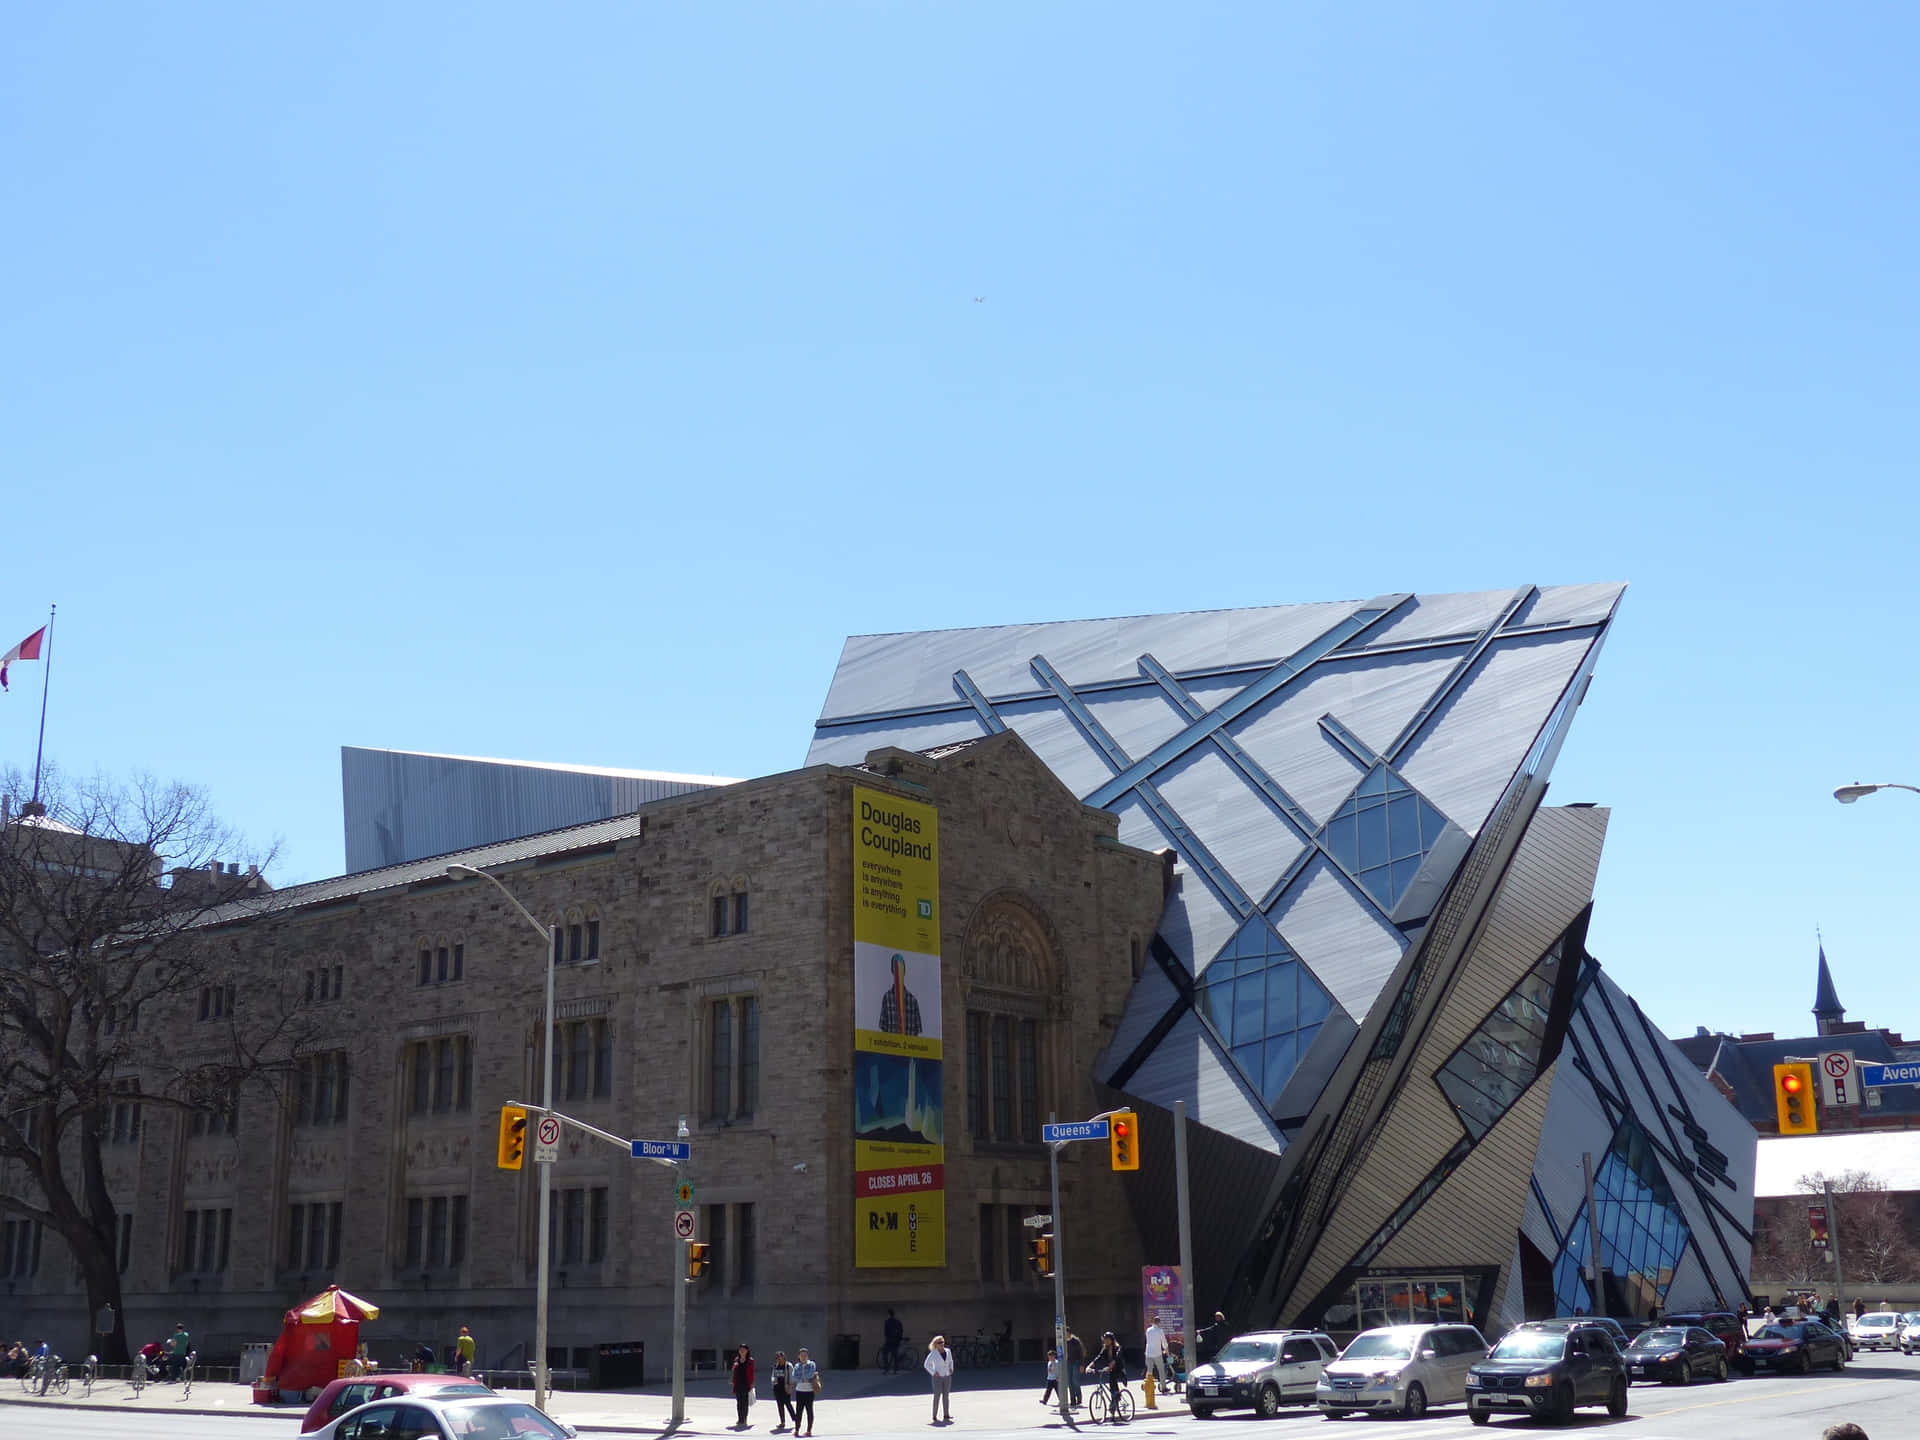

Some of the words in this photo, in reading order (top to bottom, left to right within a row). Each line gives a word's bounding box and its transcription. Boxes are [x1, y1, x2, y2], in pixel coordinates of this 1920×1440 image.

[862, 801, 921, 834] Douglas
[862, 827, 931, 861] Coupland
[863, 861, 902, 877] everywhere
[863, 872, 869, 881] is
[871, 875, 903, 889] anywhere
[863, 886, 869, 895] is
[871, 887, 900, 904] anything
[863, 898, 869, 907] is
[872, 901, 907, 918] everything
[918, 902, 931, 915] TD
[1882, 1066, 1920, 1081] Aven
[1051, 1126, 1091, 1137] Queens
[643, 1143, 666, 1154] Bloor
[672, 1144, 680, 1156] W
[868, 1175, 896, 1190] CLOSES
[898, 1173, 920, 1187] APRIL
[921, 1172, 932, 1185] 26
